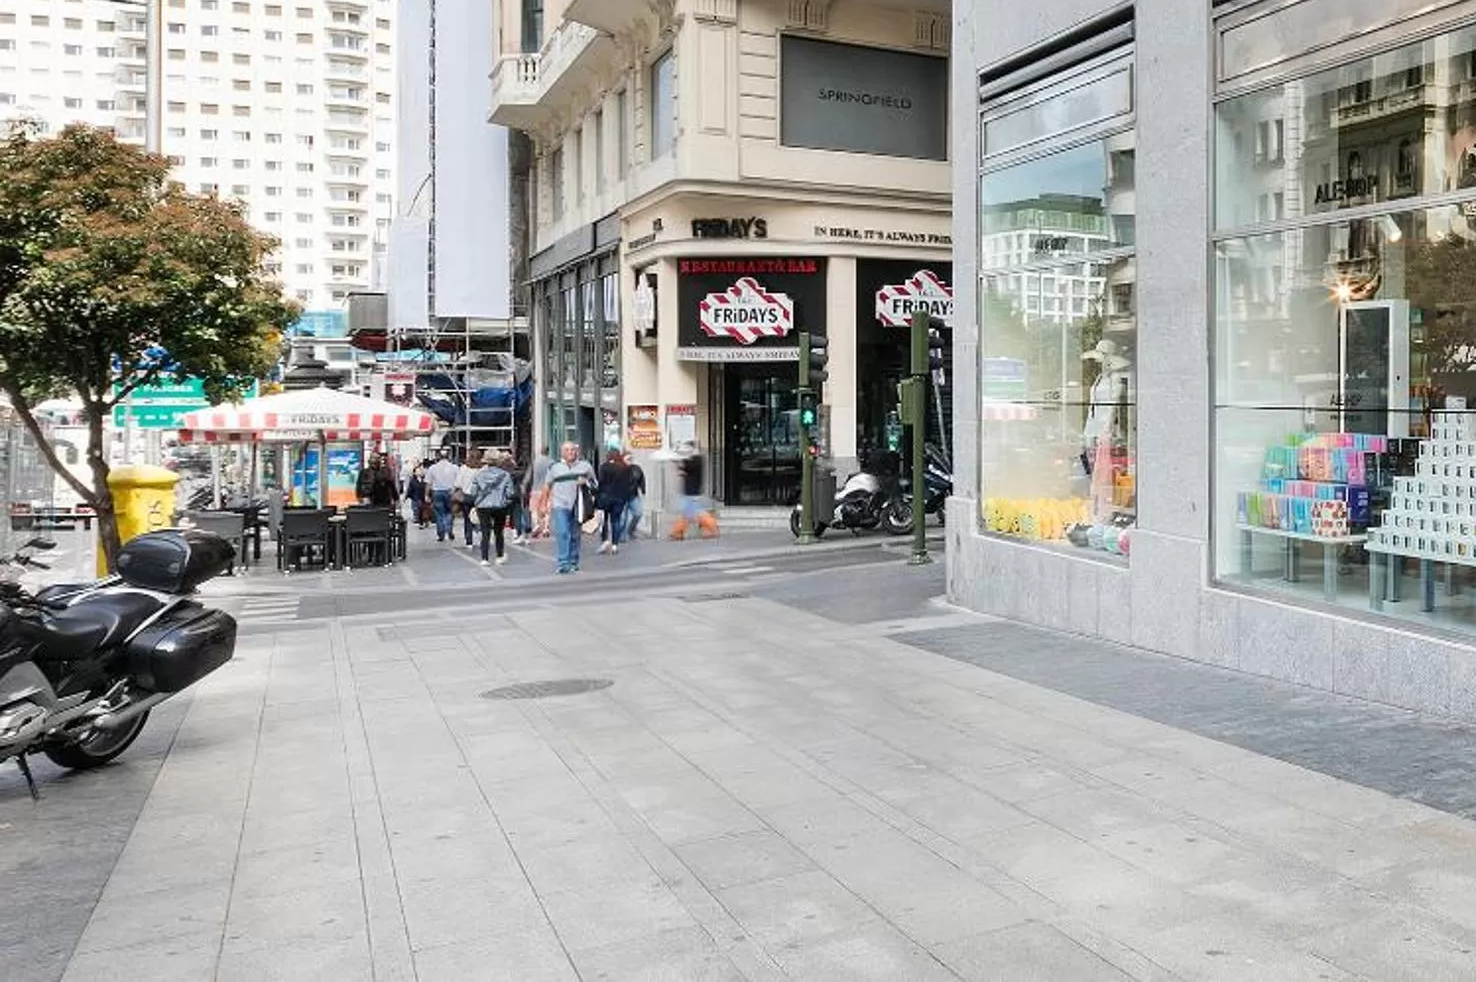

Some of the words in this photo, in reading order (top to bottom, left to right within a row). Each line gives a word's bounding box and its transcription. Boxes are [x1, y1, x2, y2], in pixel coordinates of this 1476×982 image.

[819, 88, 912, 109] SPRINGFIELD
[814, 226, 826, 236] IN
[886, 231, 925, 242] ALWAYS
